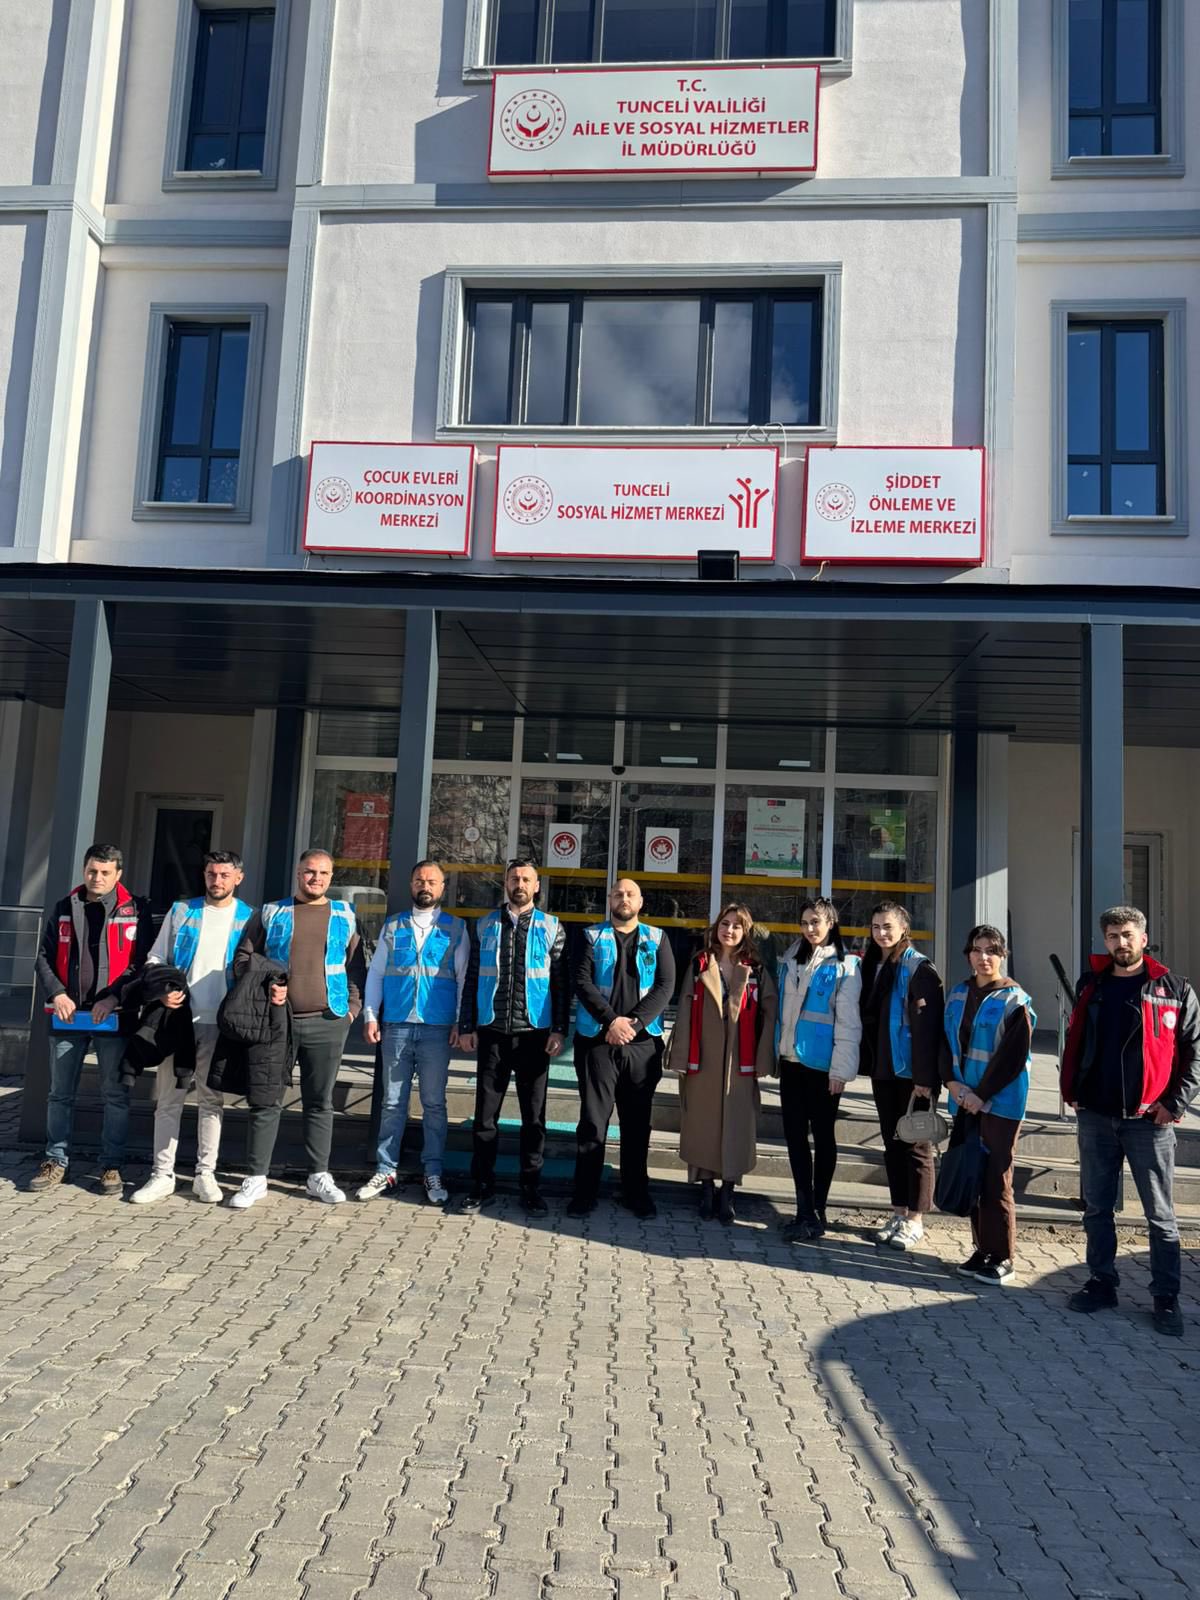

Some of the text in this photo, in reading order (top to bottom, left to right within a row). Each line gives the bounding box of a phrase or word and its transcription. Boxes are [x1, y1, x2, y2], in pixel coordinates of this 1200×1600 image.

[677, 79, 707, 92] T.C.
[617, 96, 766, 114] TUNCELİ VALİLİĞİ
[572, 118, 810, 136] AİLE VE SOSYAL HİZMETLER
[621, 139, 757, 157] İL MÜDÜRLÜĞÜ
[363, 469, 459, 486] ÇOCUK EVLERİ
[885, 472, 941, 491] ŞİDDET
[354, 489, 465, 507] KOORDİNASYON
[613, 481, 671, 497] TUNCELİ
[556, 502, 725, 521] SOSYAL HİZMET MERKEZİ
[868, 494, 933, 512] ÖNLEME
[936, 497, 957, 512] VE
[379, 512, 439, 528] MERKEZİ
[850, 517, 977, 535] İZLEME MERKEZİ
